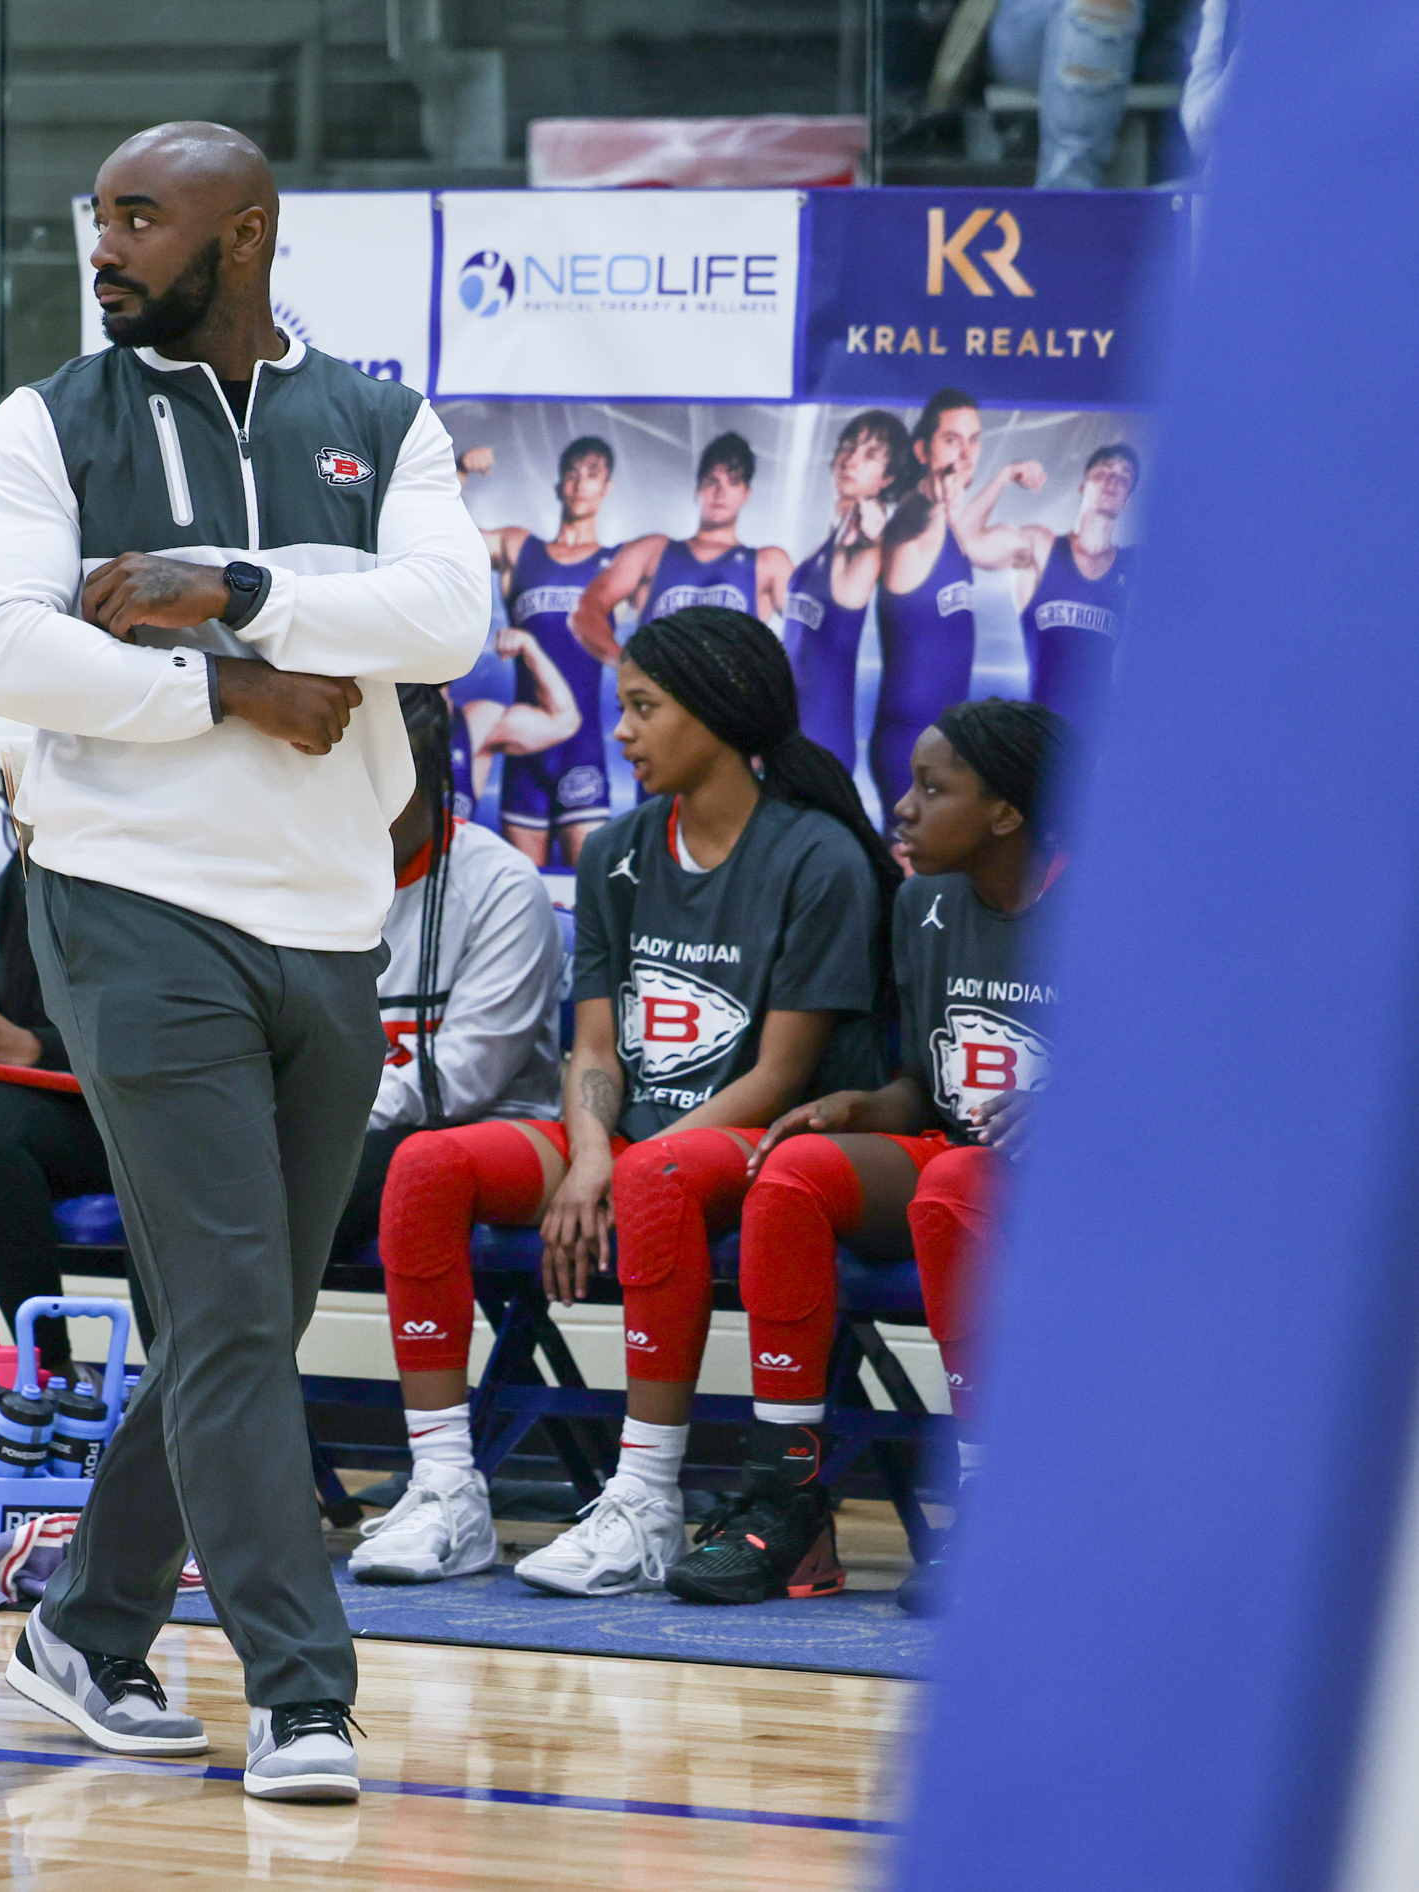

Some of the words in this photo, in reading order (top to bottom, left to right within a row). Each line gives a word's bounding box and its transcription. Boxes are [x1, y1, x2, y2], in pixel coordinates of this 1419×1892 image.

[523, 254, 778, 297] NEOLIFE
[846, 325, 946, 355] KRAL
[966, 327, 1115, 358] REALTY
[333, 458, 359, 477] B
[630, 933, 674, 958] LADY
[947, 977, 984, 999] LADY
[642, 997, 701, 1044] B
[961, 1041, 1018, 1091] B
